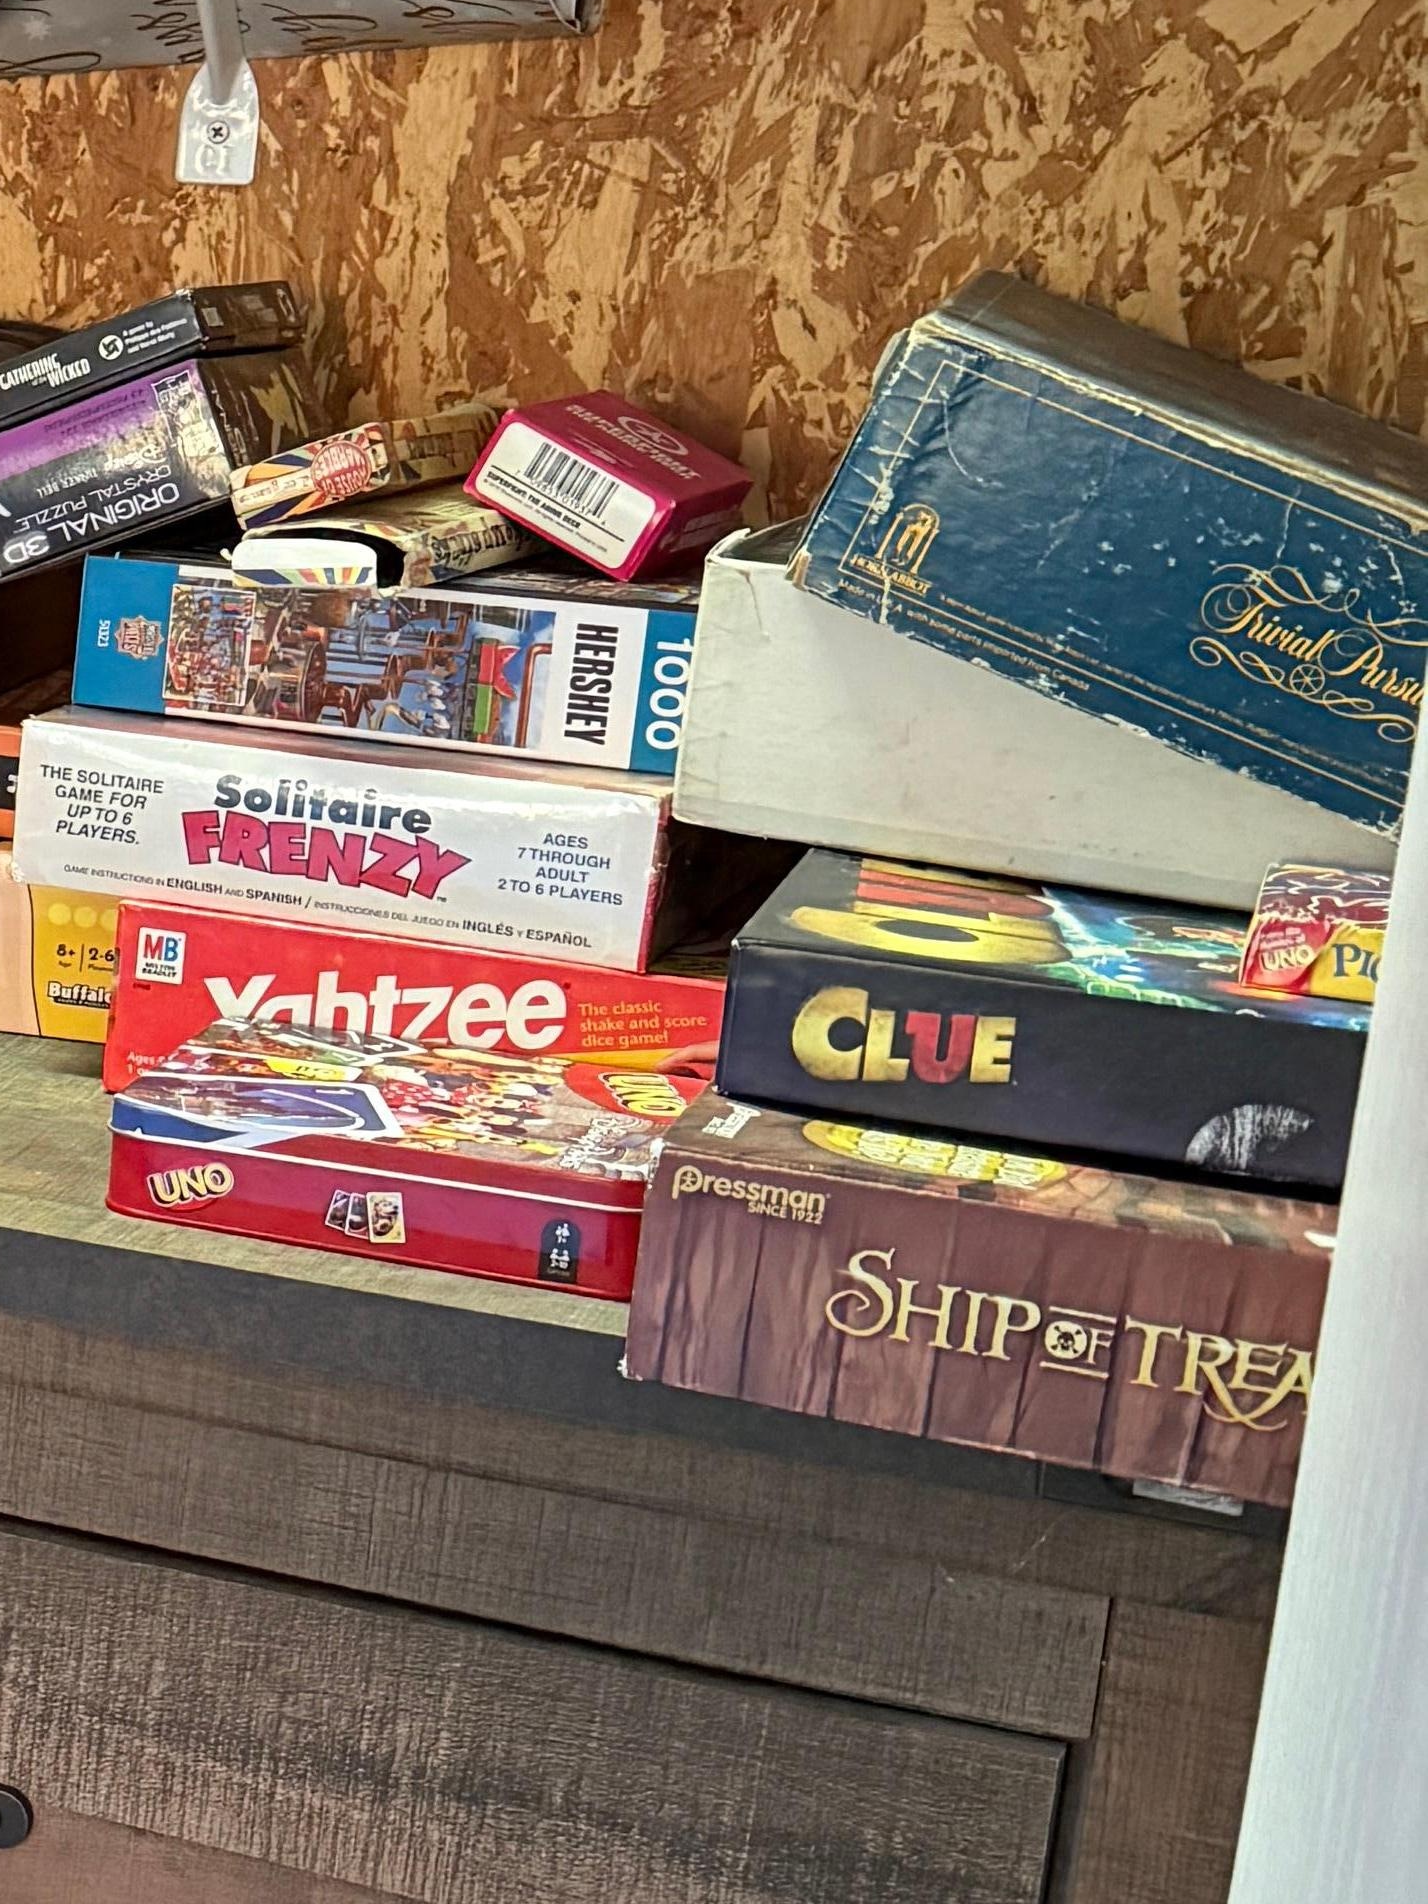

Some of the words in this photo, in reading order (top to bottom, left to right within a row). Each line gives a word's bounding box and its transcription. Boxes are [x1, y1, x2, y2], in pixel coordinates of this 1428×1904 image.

[47, 357, 92, 388] WICKED
[94, 463, 173, 503] CRYSTAL
[13, 498, 88, 534] PUZZLE
[45, 481, 181, 543] ORIGINAL
[1, 533, 51, 565] 3D
[1200, 582, 1337, 663] Trivial
[982, 640, 1027, 668] imported
[1026, 658, 1051, 676] from
[1051, 667, 1091, 691] Canada
[563, 622, 620, 746] HERSHEY
[645, 637, 695, 750] 1000
[40, 764, 72, 781] THE
[77, 769, 164, 794] SOLITAIRE
[55, 785, 104, 804] GAME
[109, 792, 148, 810] FOR
[214, 774, 432, 834] Solitaire
[67, 804, 92, 818] UP
[96, 808, 118, 823] TO
[122, 811, 133, 826] 6
[55, 820, 141, 846] PLAYERS.
[543, 832, 589, 850] AGES
[181, 809, 473, 900] FRENZY
[517, 846, 526, 860] 7
[528, 848, 611, 870] THROUGH
[535, 867, 590, 884] ADULT
[90, 866, 154, 885] INSTRUCTIONS
[166, 877, 224, 896] ENGLISH
[245, 889, 302, 908] SPANISH
[462, 918, 515, 938] INGLÉS
[526, 928, 593, 949] ESPAÑOL
[497, 879, 507, 892] 2
[510, 880, 531, 894] TO
[535, 883, 546, 896] 6
[549, 884, 624, 907] PLAYERS
[56, 943, 76, 958] 8+
[88, 947, 116, 962] 2-6
[143, 933, 180, 963] MB
[1260, 943, 1316, 972] UNO
[204, 971, 568, 1051] Yahtzee
[577, 1003, 611, 1016] The
[612, 999, 663, 1016] classic
[579, 1018, 625, 1033] shake
[628, 1015, 660, 1030] and
[664, 1014, 708, 1029] score
[791, 986, 1018, 1085] CLUE
[581, 1032, 615, 1047] dice
[618, 1030, 669, 1049] game!
[127, 1051, 155, 1065] Ages
[146, 1160, 236, 1208] UNO
[747, 1199, 787, 1220] SINCE
[791, 1207, 824, 1226] 1922
[824, 1246, 1043, 1362] SHIP
